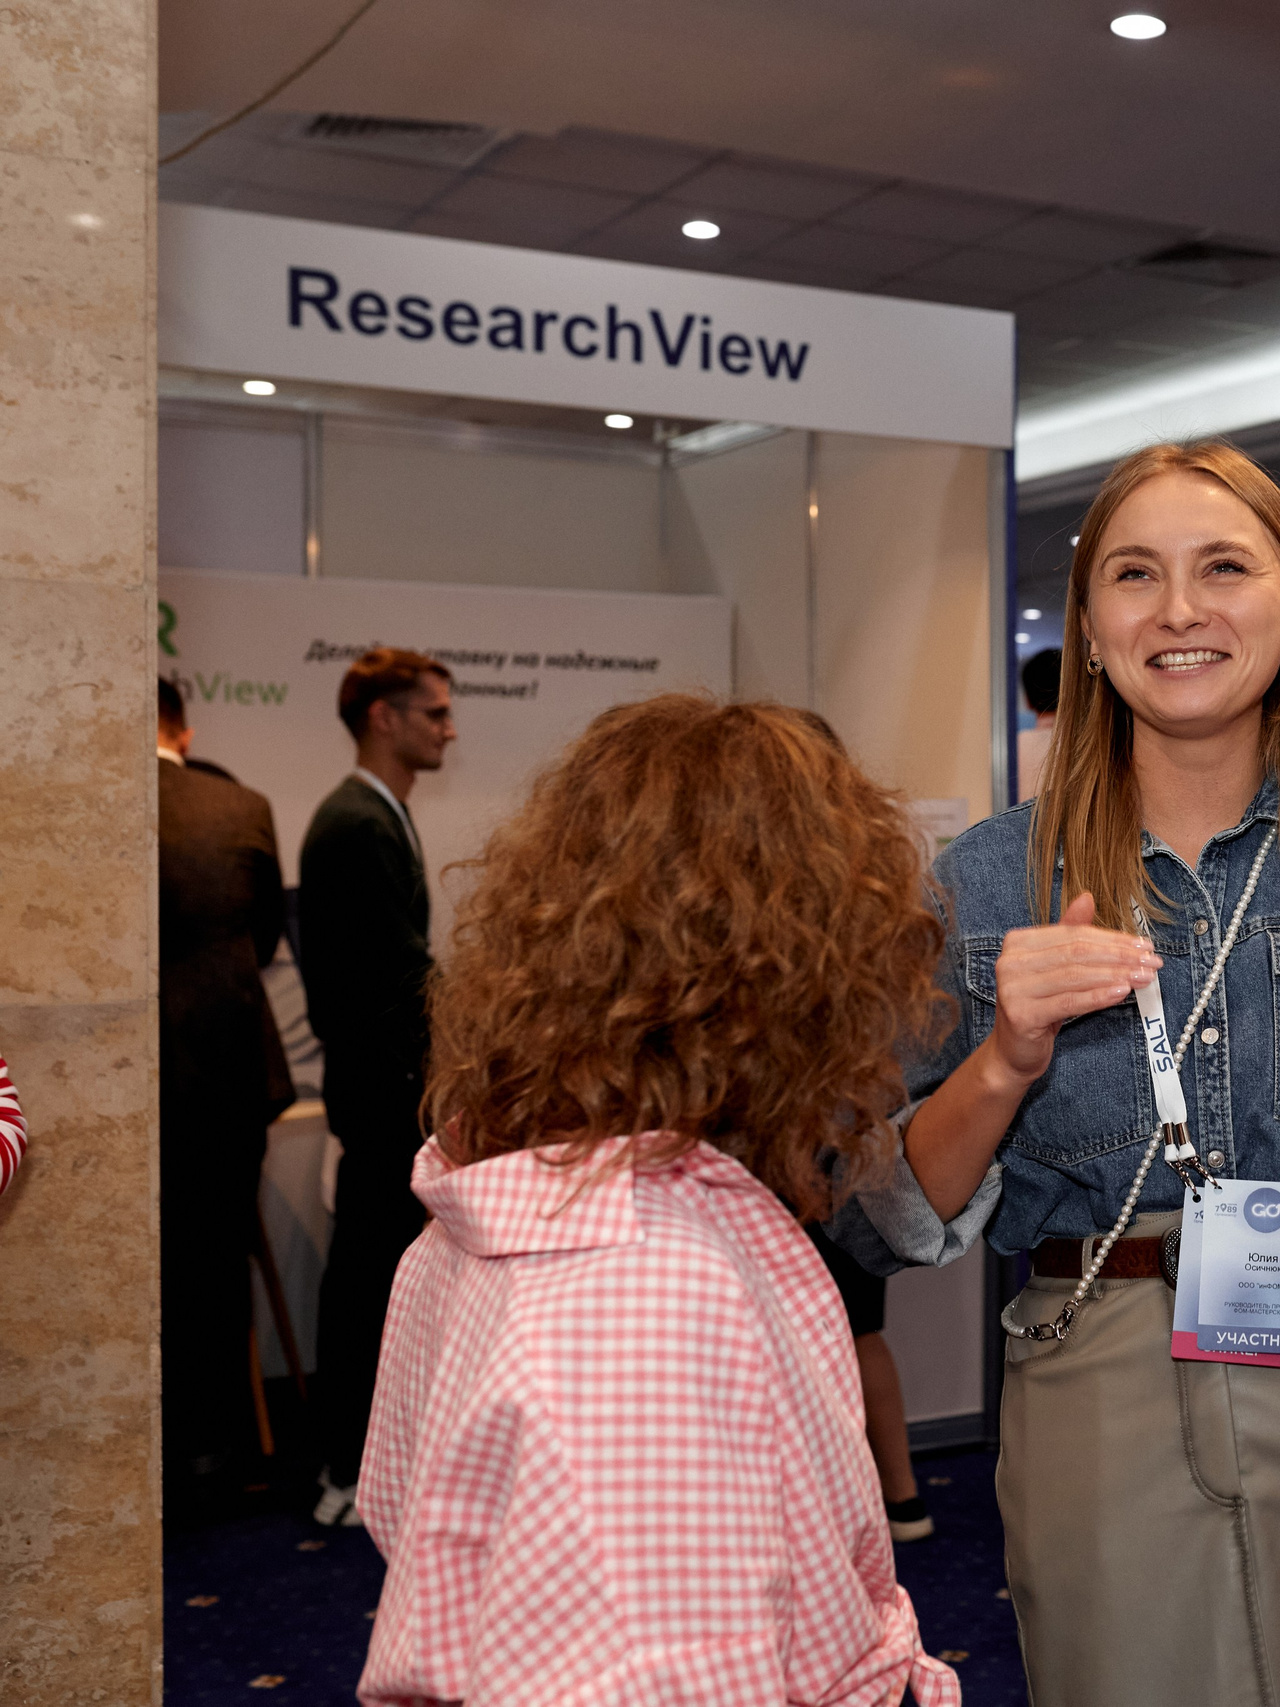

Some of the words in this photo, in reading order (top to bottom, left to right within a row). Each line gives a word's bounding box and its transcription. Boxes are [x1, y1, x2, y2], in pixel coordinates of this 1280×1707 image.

[288, 266, 810, 382] ResearchView
[510, 651, 540, 669] на
[1144, 1016, 1174, 1073] SALT
[1248, 1252, 1279, 1263] Юлия
[1238, 1281, 1255, 1289] ООО
[1224, 1301, 1271, 1309] РУКОВОДИТЕЛЬ
